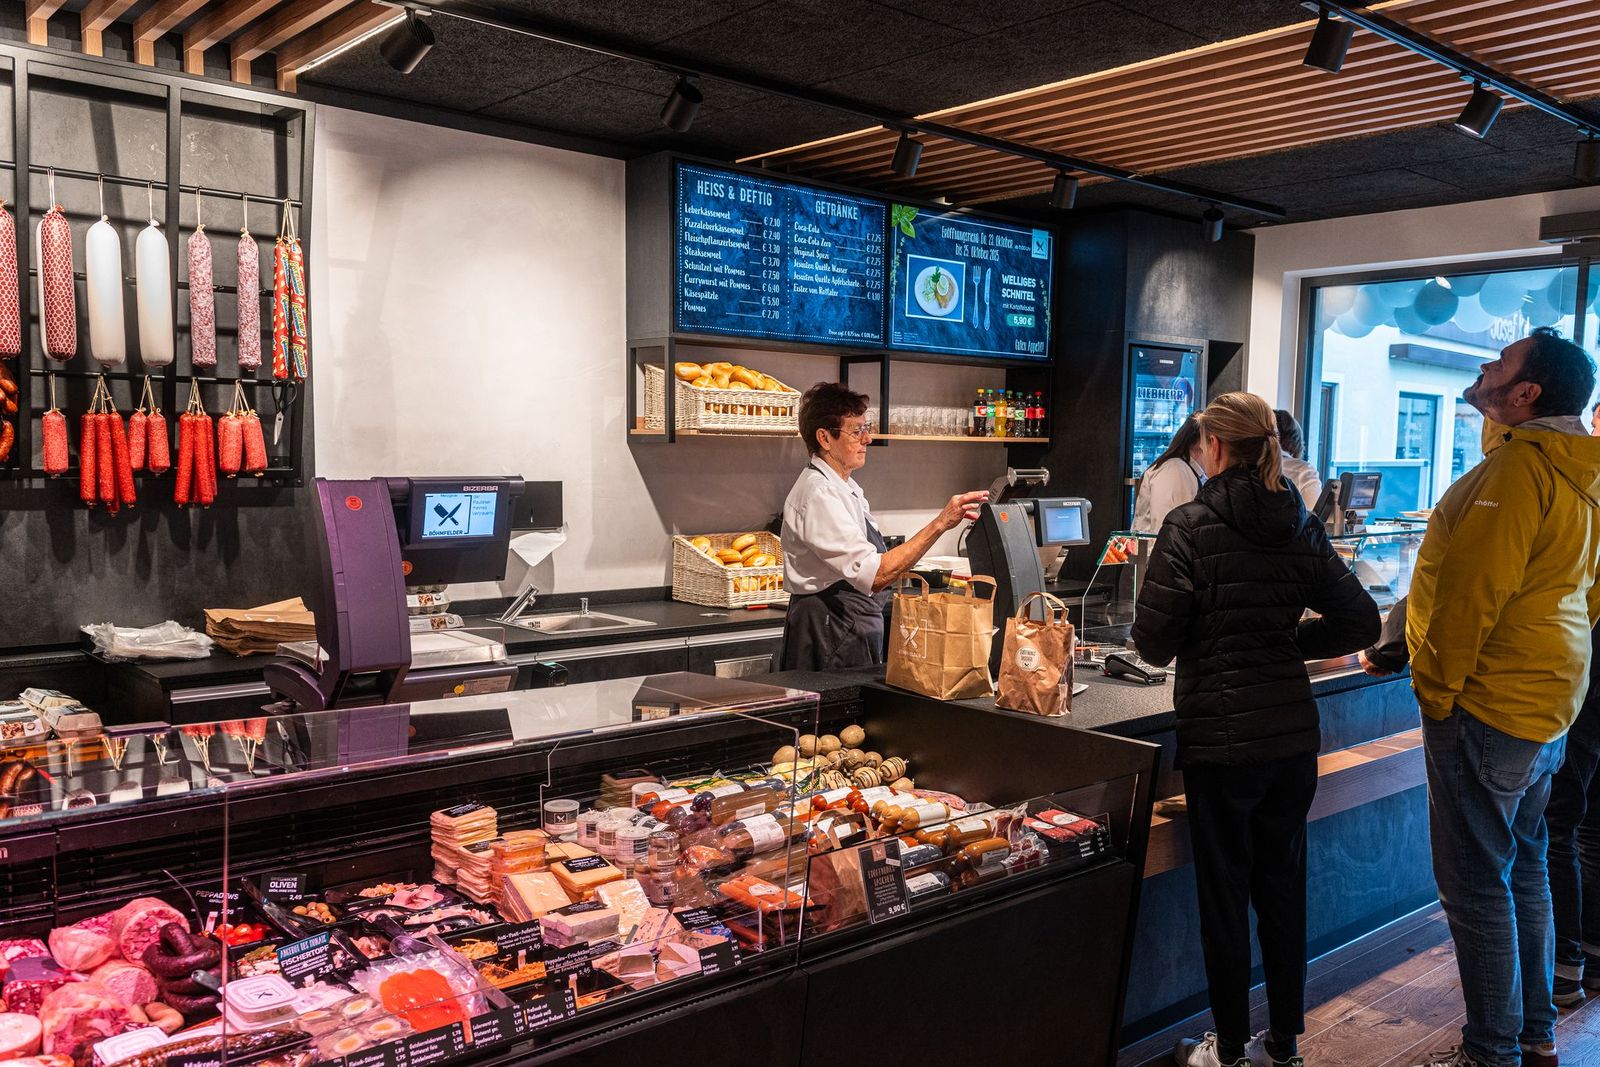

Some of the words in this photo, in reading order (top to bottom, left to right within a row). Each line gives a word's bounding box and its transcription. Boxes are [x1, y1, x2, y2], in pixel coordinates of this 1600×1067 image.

[697, 180, 725, 198] HEISS
[728, 185, 735, 200] &
[740, 188, 773, 206] DEFTIG
[684, 203, 731, 220] Leberkässemmel
[815, 200, 858, 220] GETRÄNKE
[684, 217, 744, 236] Pizzaleberkässemmel
[794, 221, 820, 234] Coca-Cola
[794, 233, 820, 246] Coca-Cola
[684, 245, 722, 260] Steaksemmel
[684, 259, 712, 272] Schnitzel
[713, 263, 723, 274] mit
[684, 273, 718, 287] Currywurst
[719, 278, 728, 288] mit
[1002, 274, 1036, 288] WELLIGES
[684, 287, 719, 301] Käsespätzle
[1002, 288, 1035, 301] SCHNITEL
[684, 301, 707, 313] Pommes
[1027, 317, 1033, 326] €
[1137, 387, 1184, 401] LIEBHERR
[269, 881, 297, 889] OLIVEN
[195, 889, 239, 900] PEPPADWS
[280, 944, 329, 968] FISCHERTOPF
